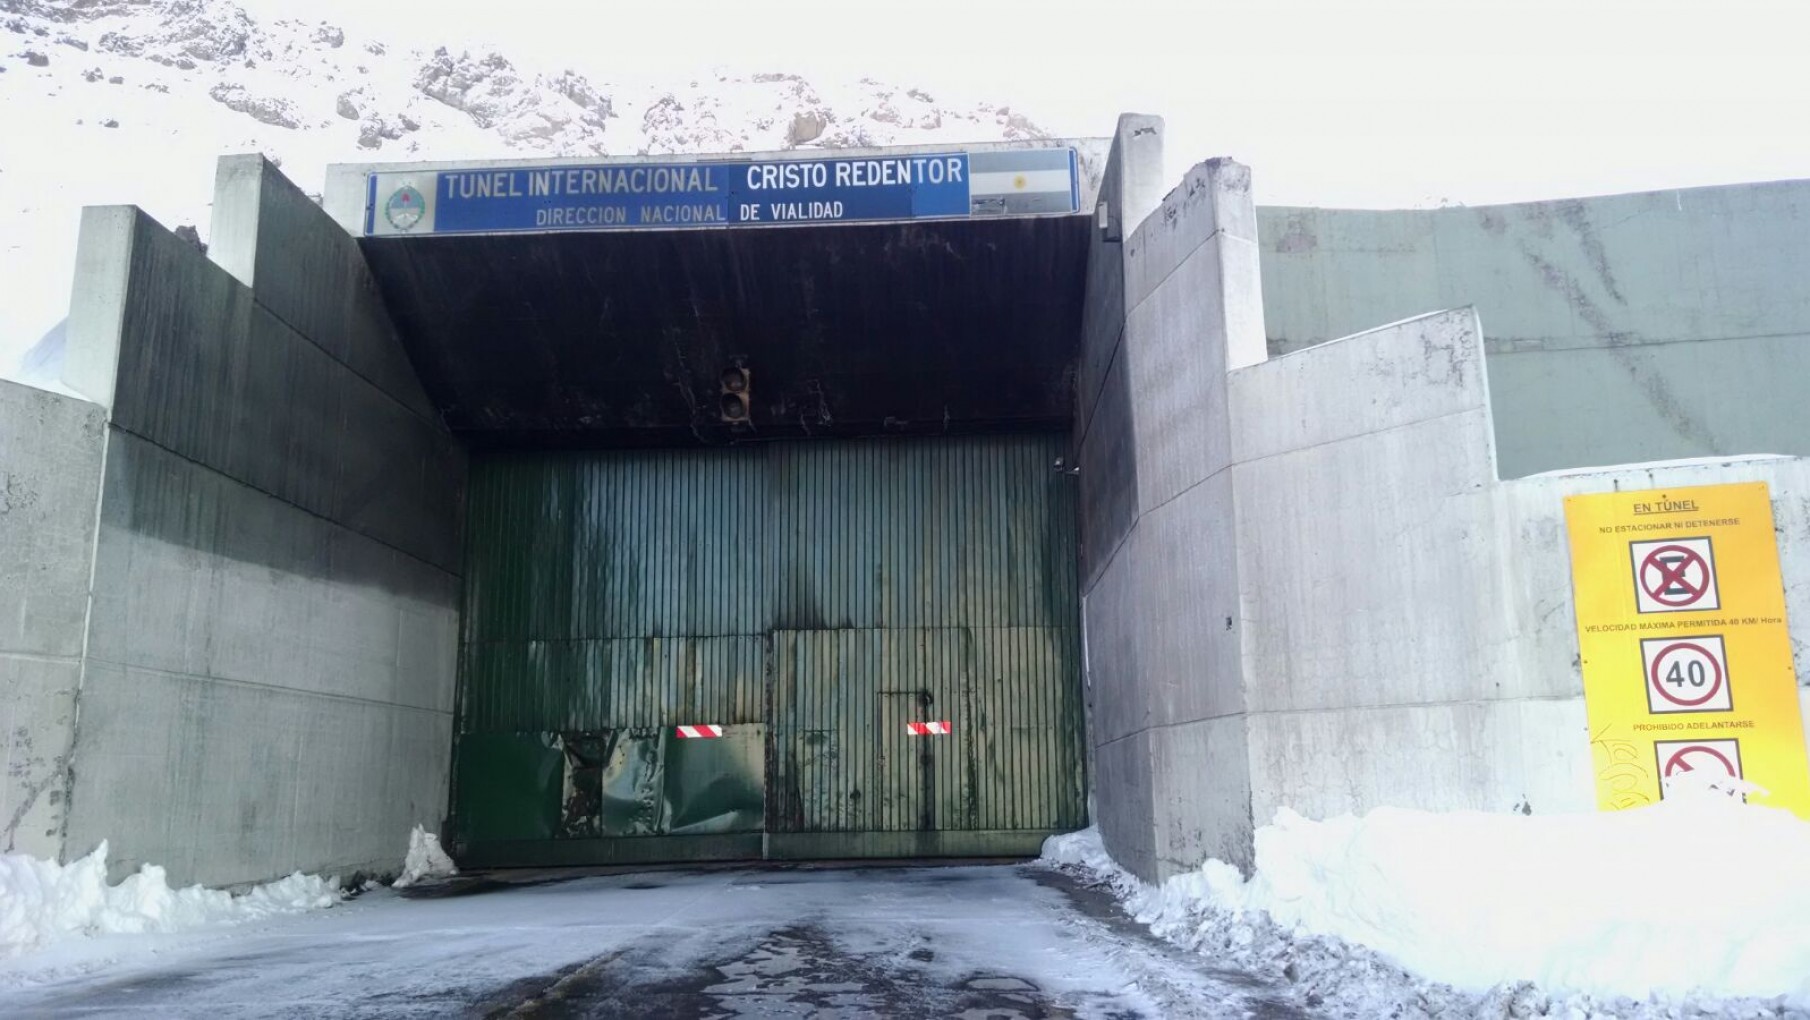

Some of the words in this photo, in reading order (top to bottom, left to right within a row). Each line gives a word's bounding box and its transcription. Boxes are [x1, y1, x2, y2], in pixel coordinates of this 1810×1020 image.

[446, 174, 522, 198] TUNEL
[528, 167, 719, 195] INTERNACIONAL
[747, 163, 827, 190] CRISTO
[835, 158, 963, 187] REDENTOR
[535, 207, 627, 226] DIRECCION
[639, 204, 727, 222] NACIONAL
[739, 204, 761, 221] DE
[770, 201, 844, 220] VIALIDAD
[1633, 503, 1652, 513] EN
[1599, 526, 1613, 534] NO
[1615, 522, 1672, 533] ESTACIONAR
[1685, 518, 1741, 528] DETENERSE
[1585, 623, 1637, 633] VELOCIDAD
[1677, 619, 1727, 628] PERMITIDA
[1729, 618, 1740, 626] 40
[1666, 660, 1706, 688] 40
[1633, 722, 1684, 732] PROHIBIDO
[1686, 720, 1755, 730] ADELANTARSE
